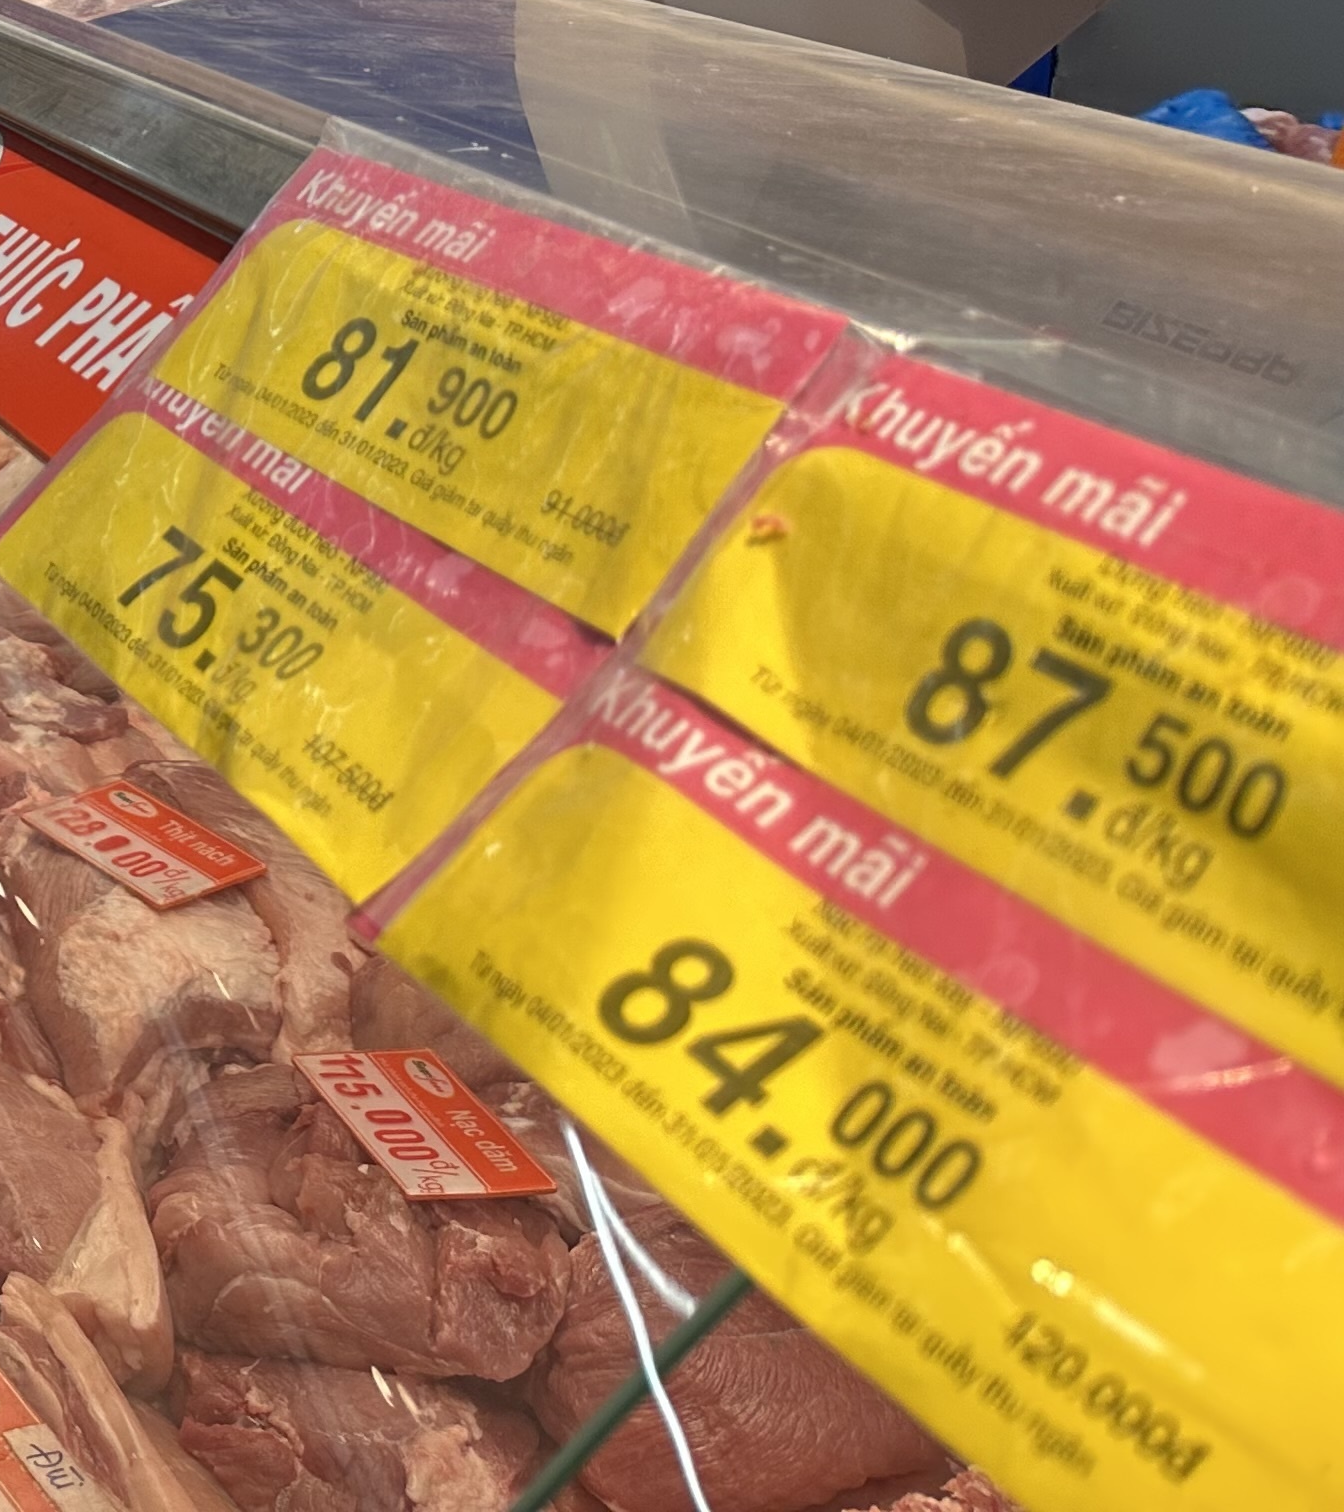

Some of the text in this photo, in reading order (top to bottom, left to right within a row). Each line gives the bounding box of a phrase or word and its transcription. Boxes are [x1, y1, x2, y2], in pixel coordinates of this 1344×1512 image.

[296, 168, 496, 264] Khuyến mãi
[427, 366, 518, 440] 900
[398, 423, 471, 479] đ/kg
[406, 463, 441, 493] Giá
[831, 379, 1189, 548] Khuyến mãi
[217, 534, 346, 633] Sản phẩm an toàn
[123, 633, 157, 665] đến
[237, 606, 325, 681] 300
[588, 668, 931, 911] Khuyến mãi
[1124, 712, 1288, 842] 500
[152, 866, 193, 901] đ/kg
[157, 819, 238, 867] Thịt nách
[1095, 789, 1222, 899] đ/kg
[444, 1108, 519, 1173] Nạc dăm
[829, 1078, 985, 1211] 000
[1000, 1310, 1214, 1484] 120.000đ
